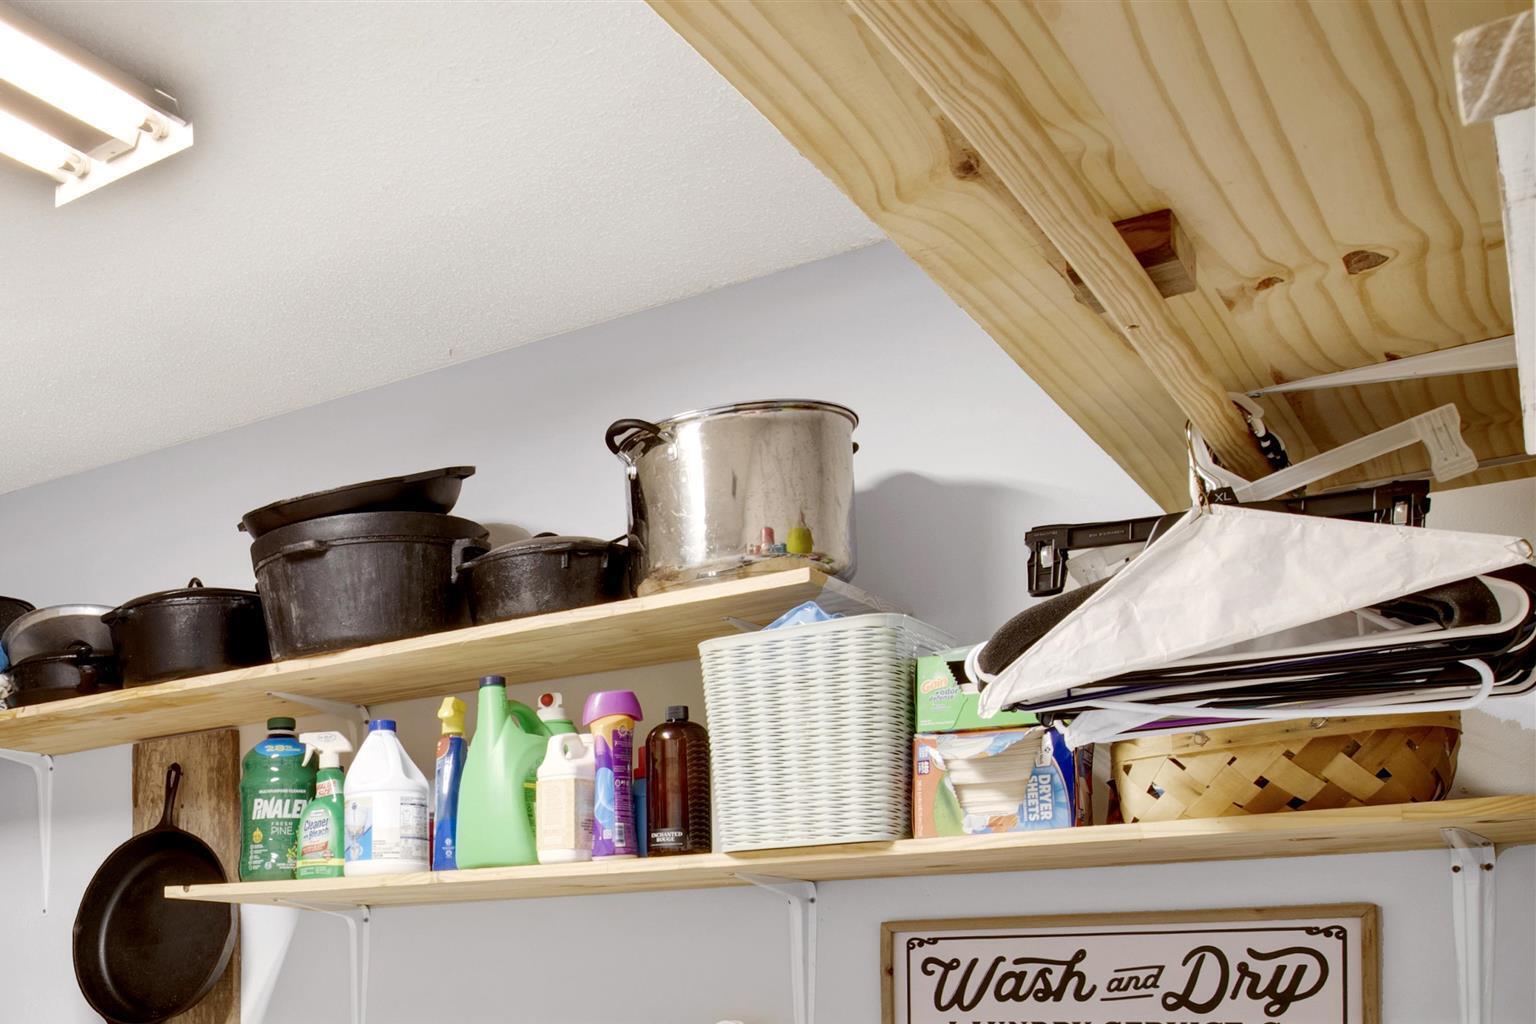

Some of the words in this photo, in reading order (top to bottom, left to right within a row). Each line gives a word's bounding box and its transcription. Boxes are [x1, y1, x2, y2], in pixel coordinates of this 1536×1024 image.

[1215, 492, 1232, 502] XL
[921, 676, 949, 693] Gain
[929, 694, 954, 702] defense
[939, 687, 958, 696] odor
[1026, 775, 1039, 822] SHEETS
[1038, 774, 1052, 822] DRYER
[271, 826, 293, 835] PINE
[304, 818, 329, 831] Cleaner
[921, 948, 1097, 1013] Wash
[1106, 965, 1165, 994] and
[1162, 945, 1330, 1017] Dry
